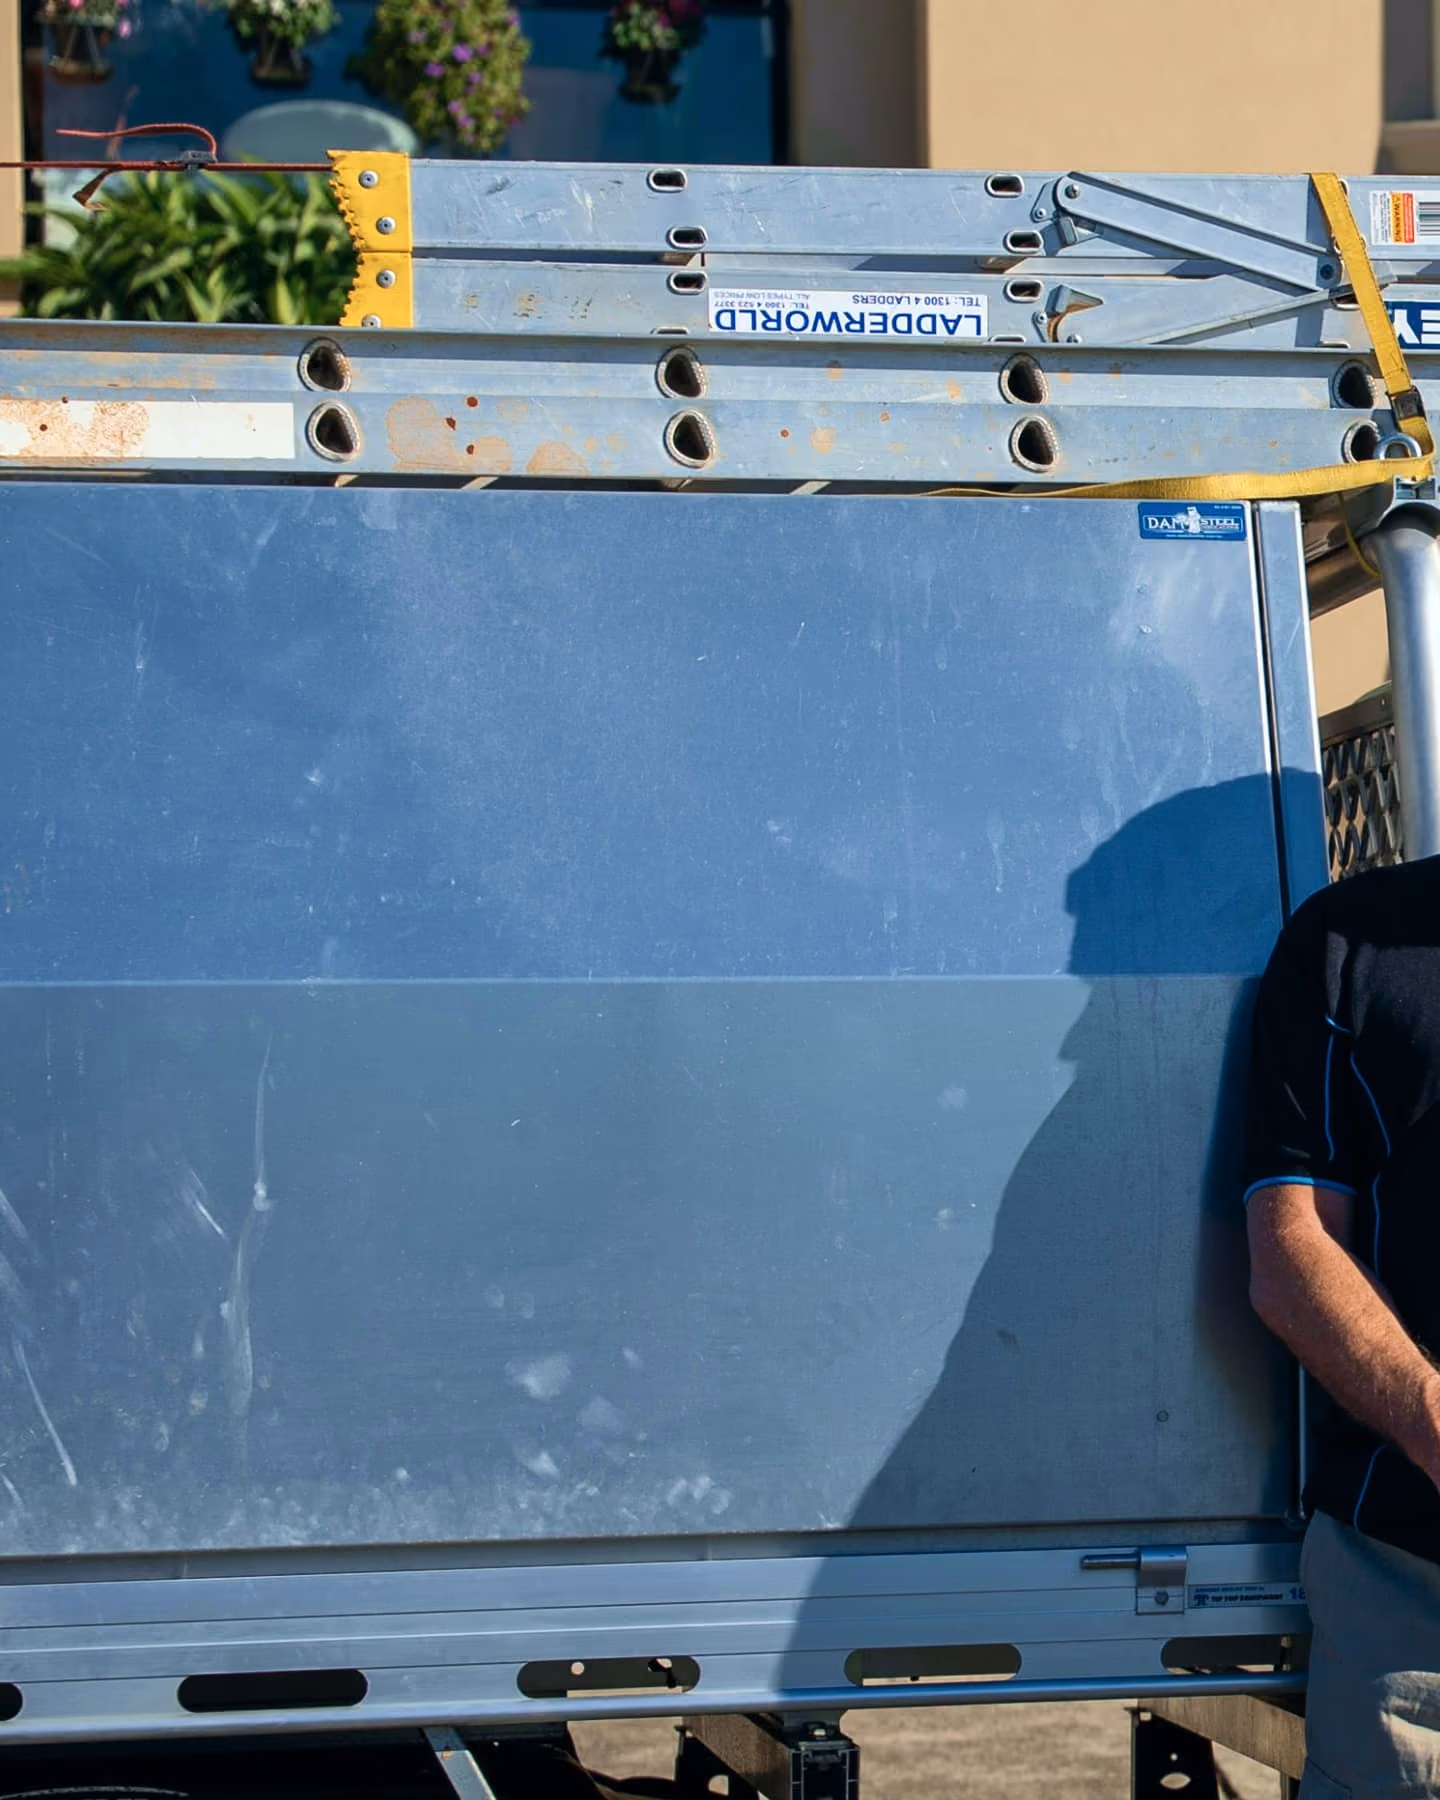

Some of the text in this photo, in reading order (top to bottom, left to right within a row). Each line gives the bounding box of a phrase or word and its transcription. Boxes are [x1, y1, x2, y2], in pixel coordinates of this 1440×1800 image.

[1394, 202, 1402, 242] WARNING
[852, 294, 981, 307] TEL: 1300 4 LADDERS
[715, 309, 981, 336] LADDERWORLD
